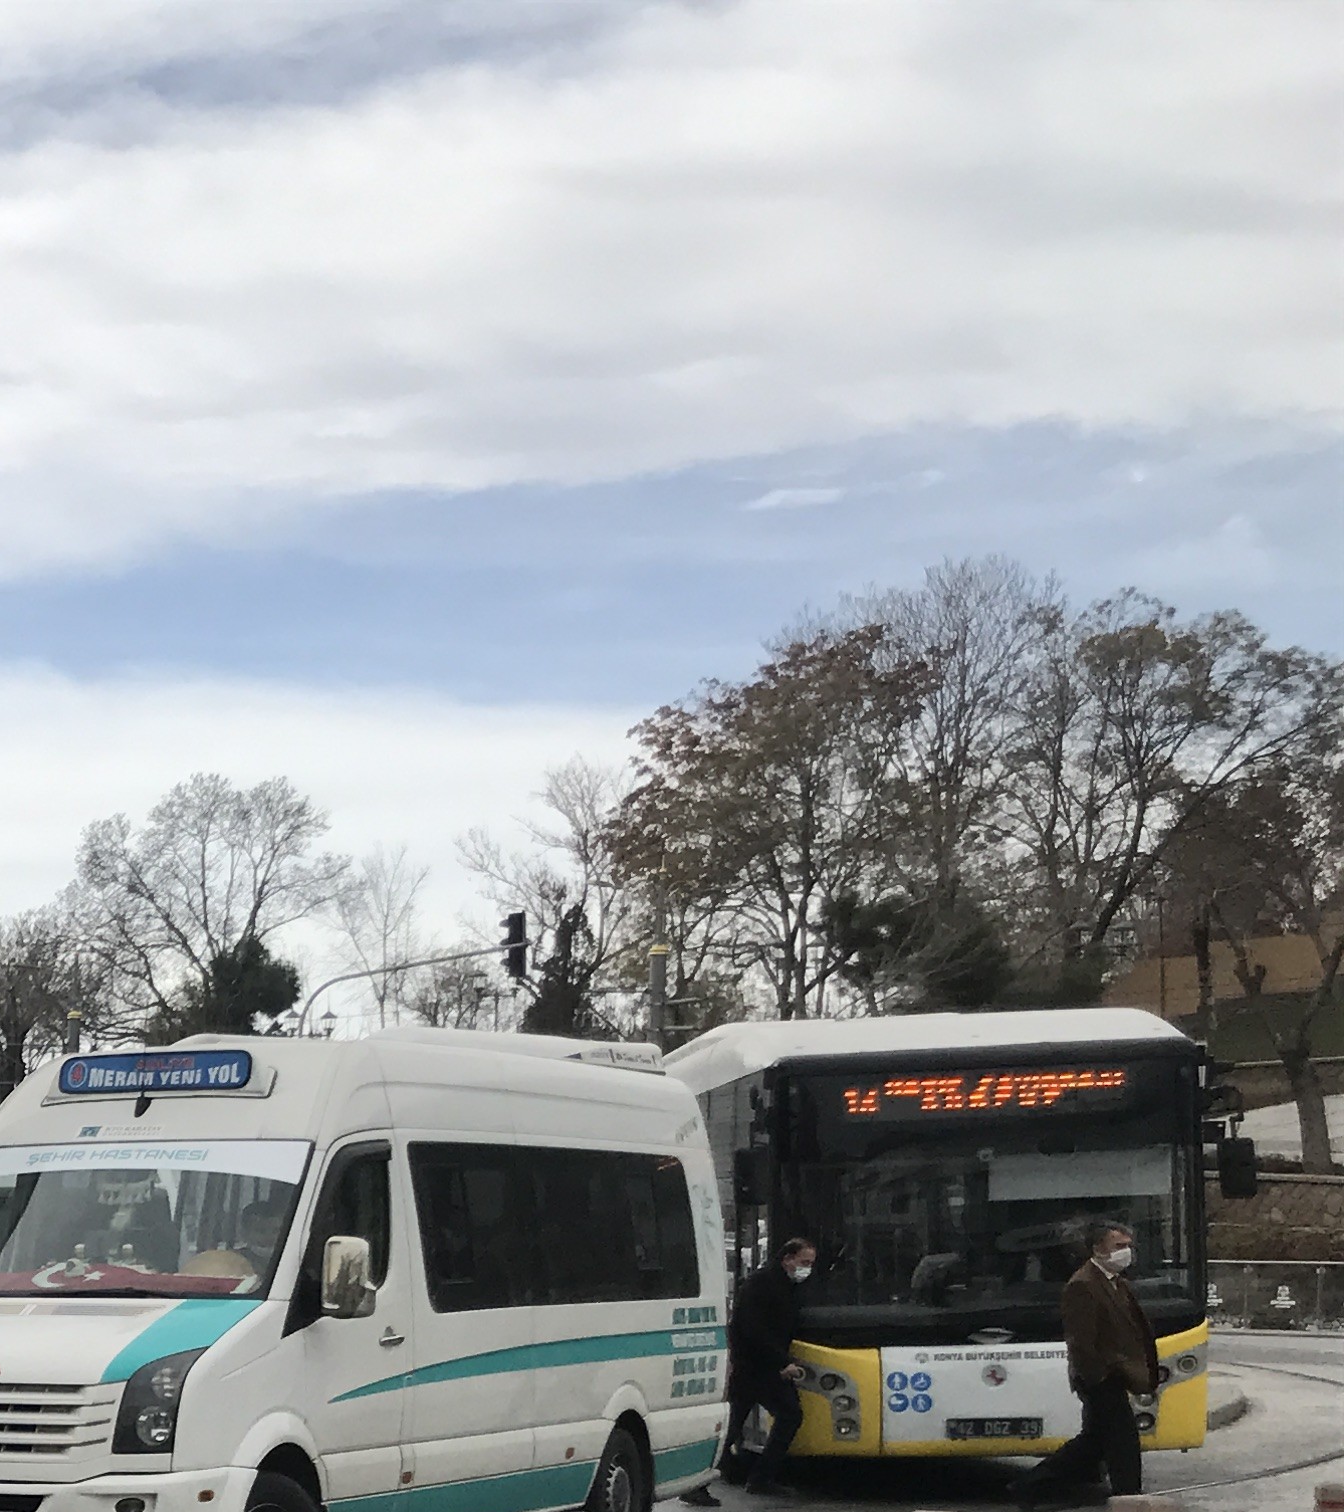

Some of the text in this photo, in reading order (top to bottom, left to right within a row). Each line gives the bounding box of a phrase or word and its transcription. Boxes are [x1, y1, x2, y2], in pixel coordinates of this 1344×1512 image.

[88, 1067, 154, 1087] MERAM
[160, 1068, 202, 1086] YENİ
[208, 1061, 240, 1083] YOL
[26, 1150, 86, 1166] ŞEHİR
[89, 1148, 210, 1163] HASTANESİ
